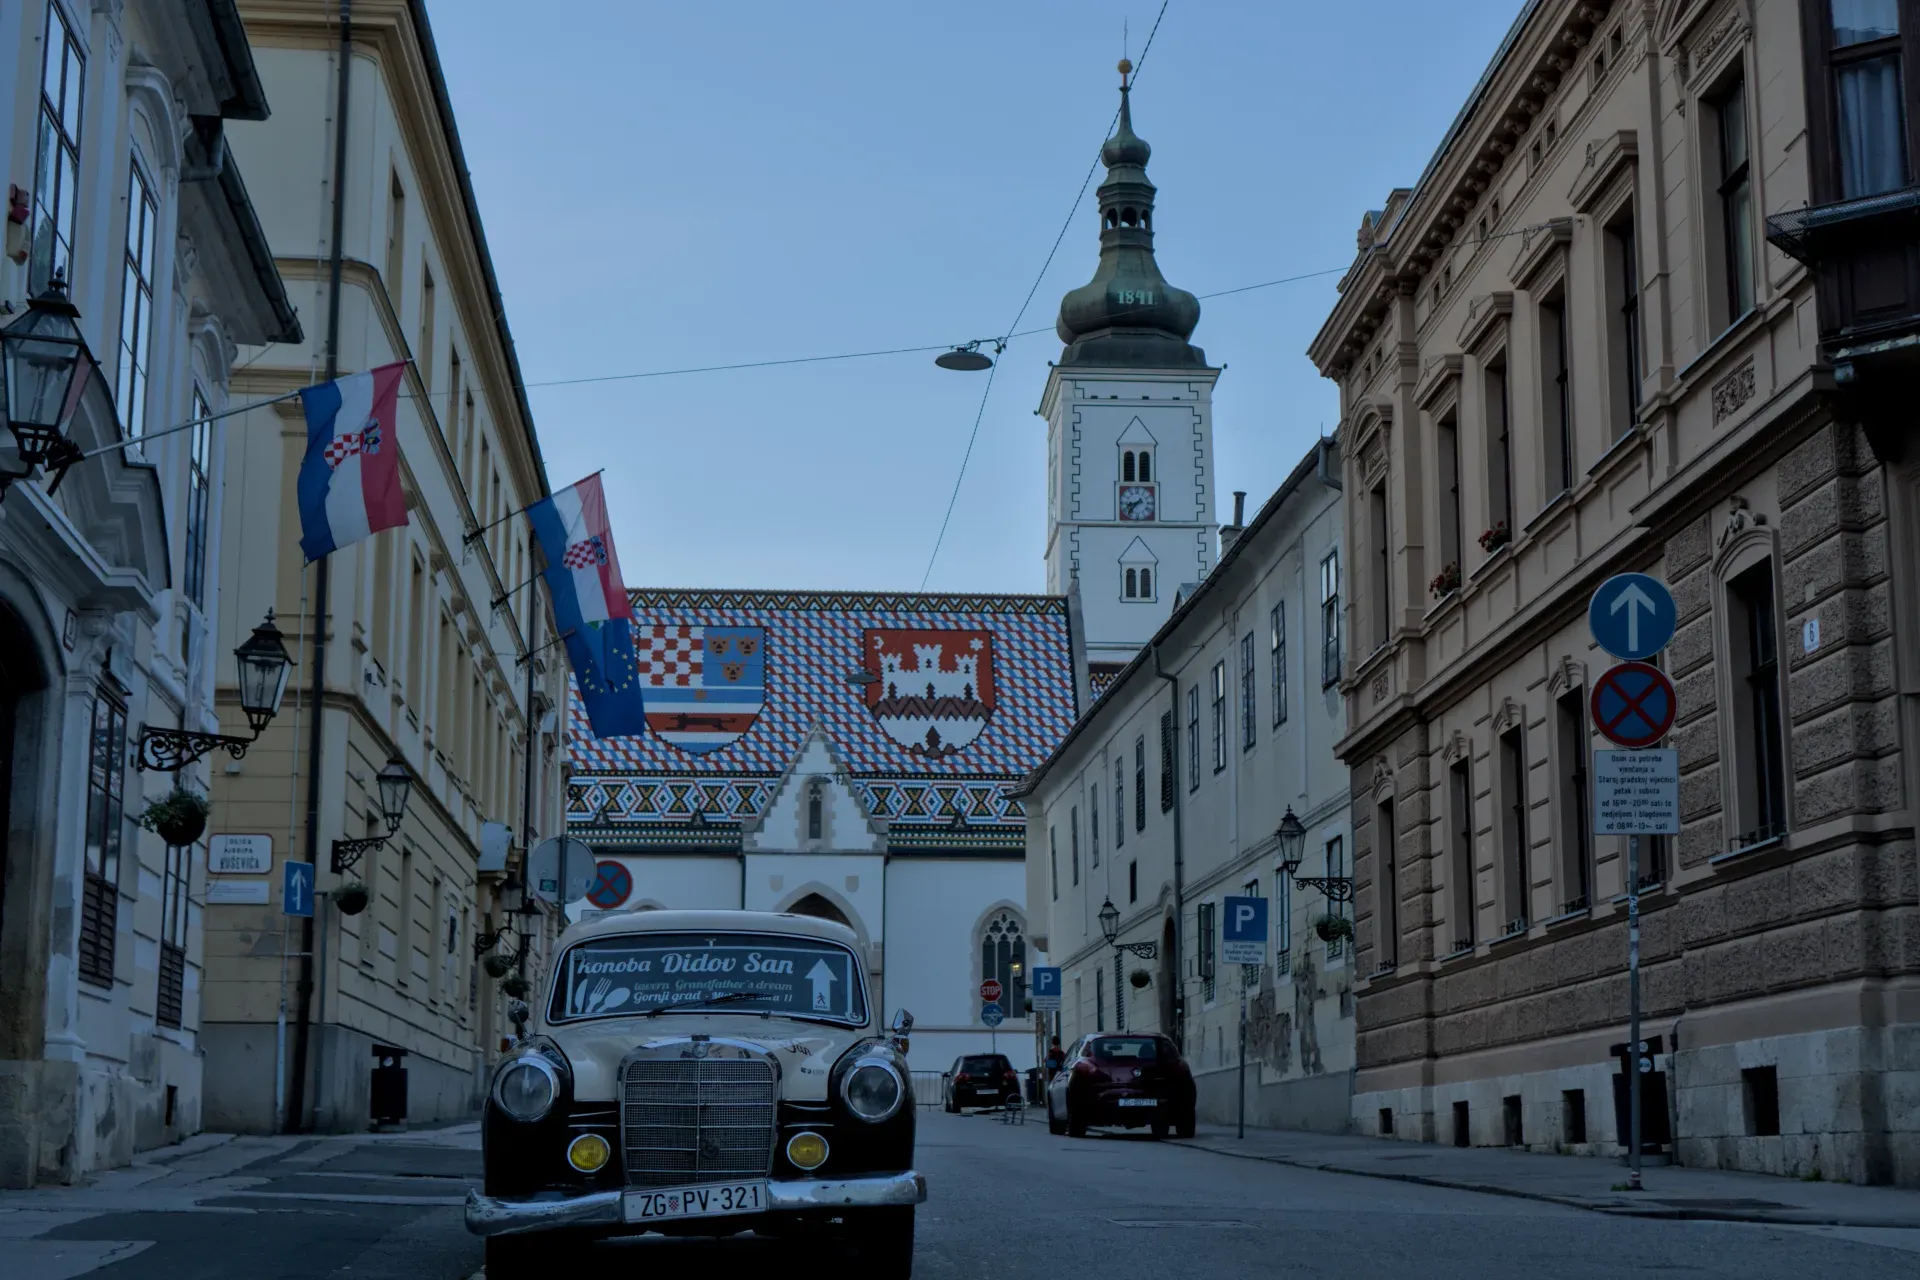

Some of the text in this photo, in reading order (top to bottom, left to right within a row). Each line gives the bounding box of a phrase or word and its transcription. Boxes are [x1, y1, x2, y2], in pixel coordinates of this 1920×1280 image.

[1116, 290, 1155, 305] 1841
[1809, 621, 1816, 642] 6
[1639, 755, 1662, 763] potrebe
[1598, 776, 1619, 784] Staroj
[1620, 776, 1648, 784] gradskoj
[1601, 810, 1633, 819] nedjeljom
[1639, 810, 1672, 819] blagdanom
[1606, 822, 1614, 830] od
[1655, 822, 1668, 830] sati
[1236, 904, 1255, 932] P
[577, 952, 794, 974] konoba Didov San
[633, 982, 670, 990] tavern
[755, 980, 793, 991] dream
[1040, 972, 1053, 991] P
[633, 991, 670, 1004] Gornji
[671, 990, 702, 1002] grad
[981, 985, 1001, 996] STOP
[640, 1185, 759, 1216] ZG PV-321
